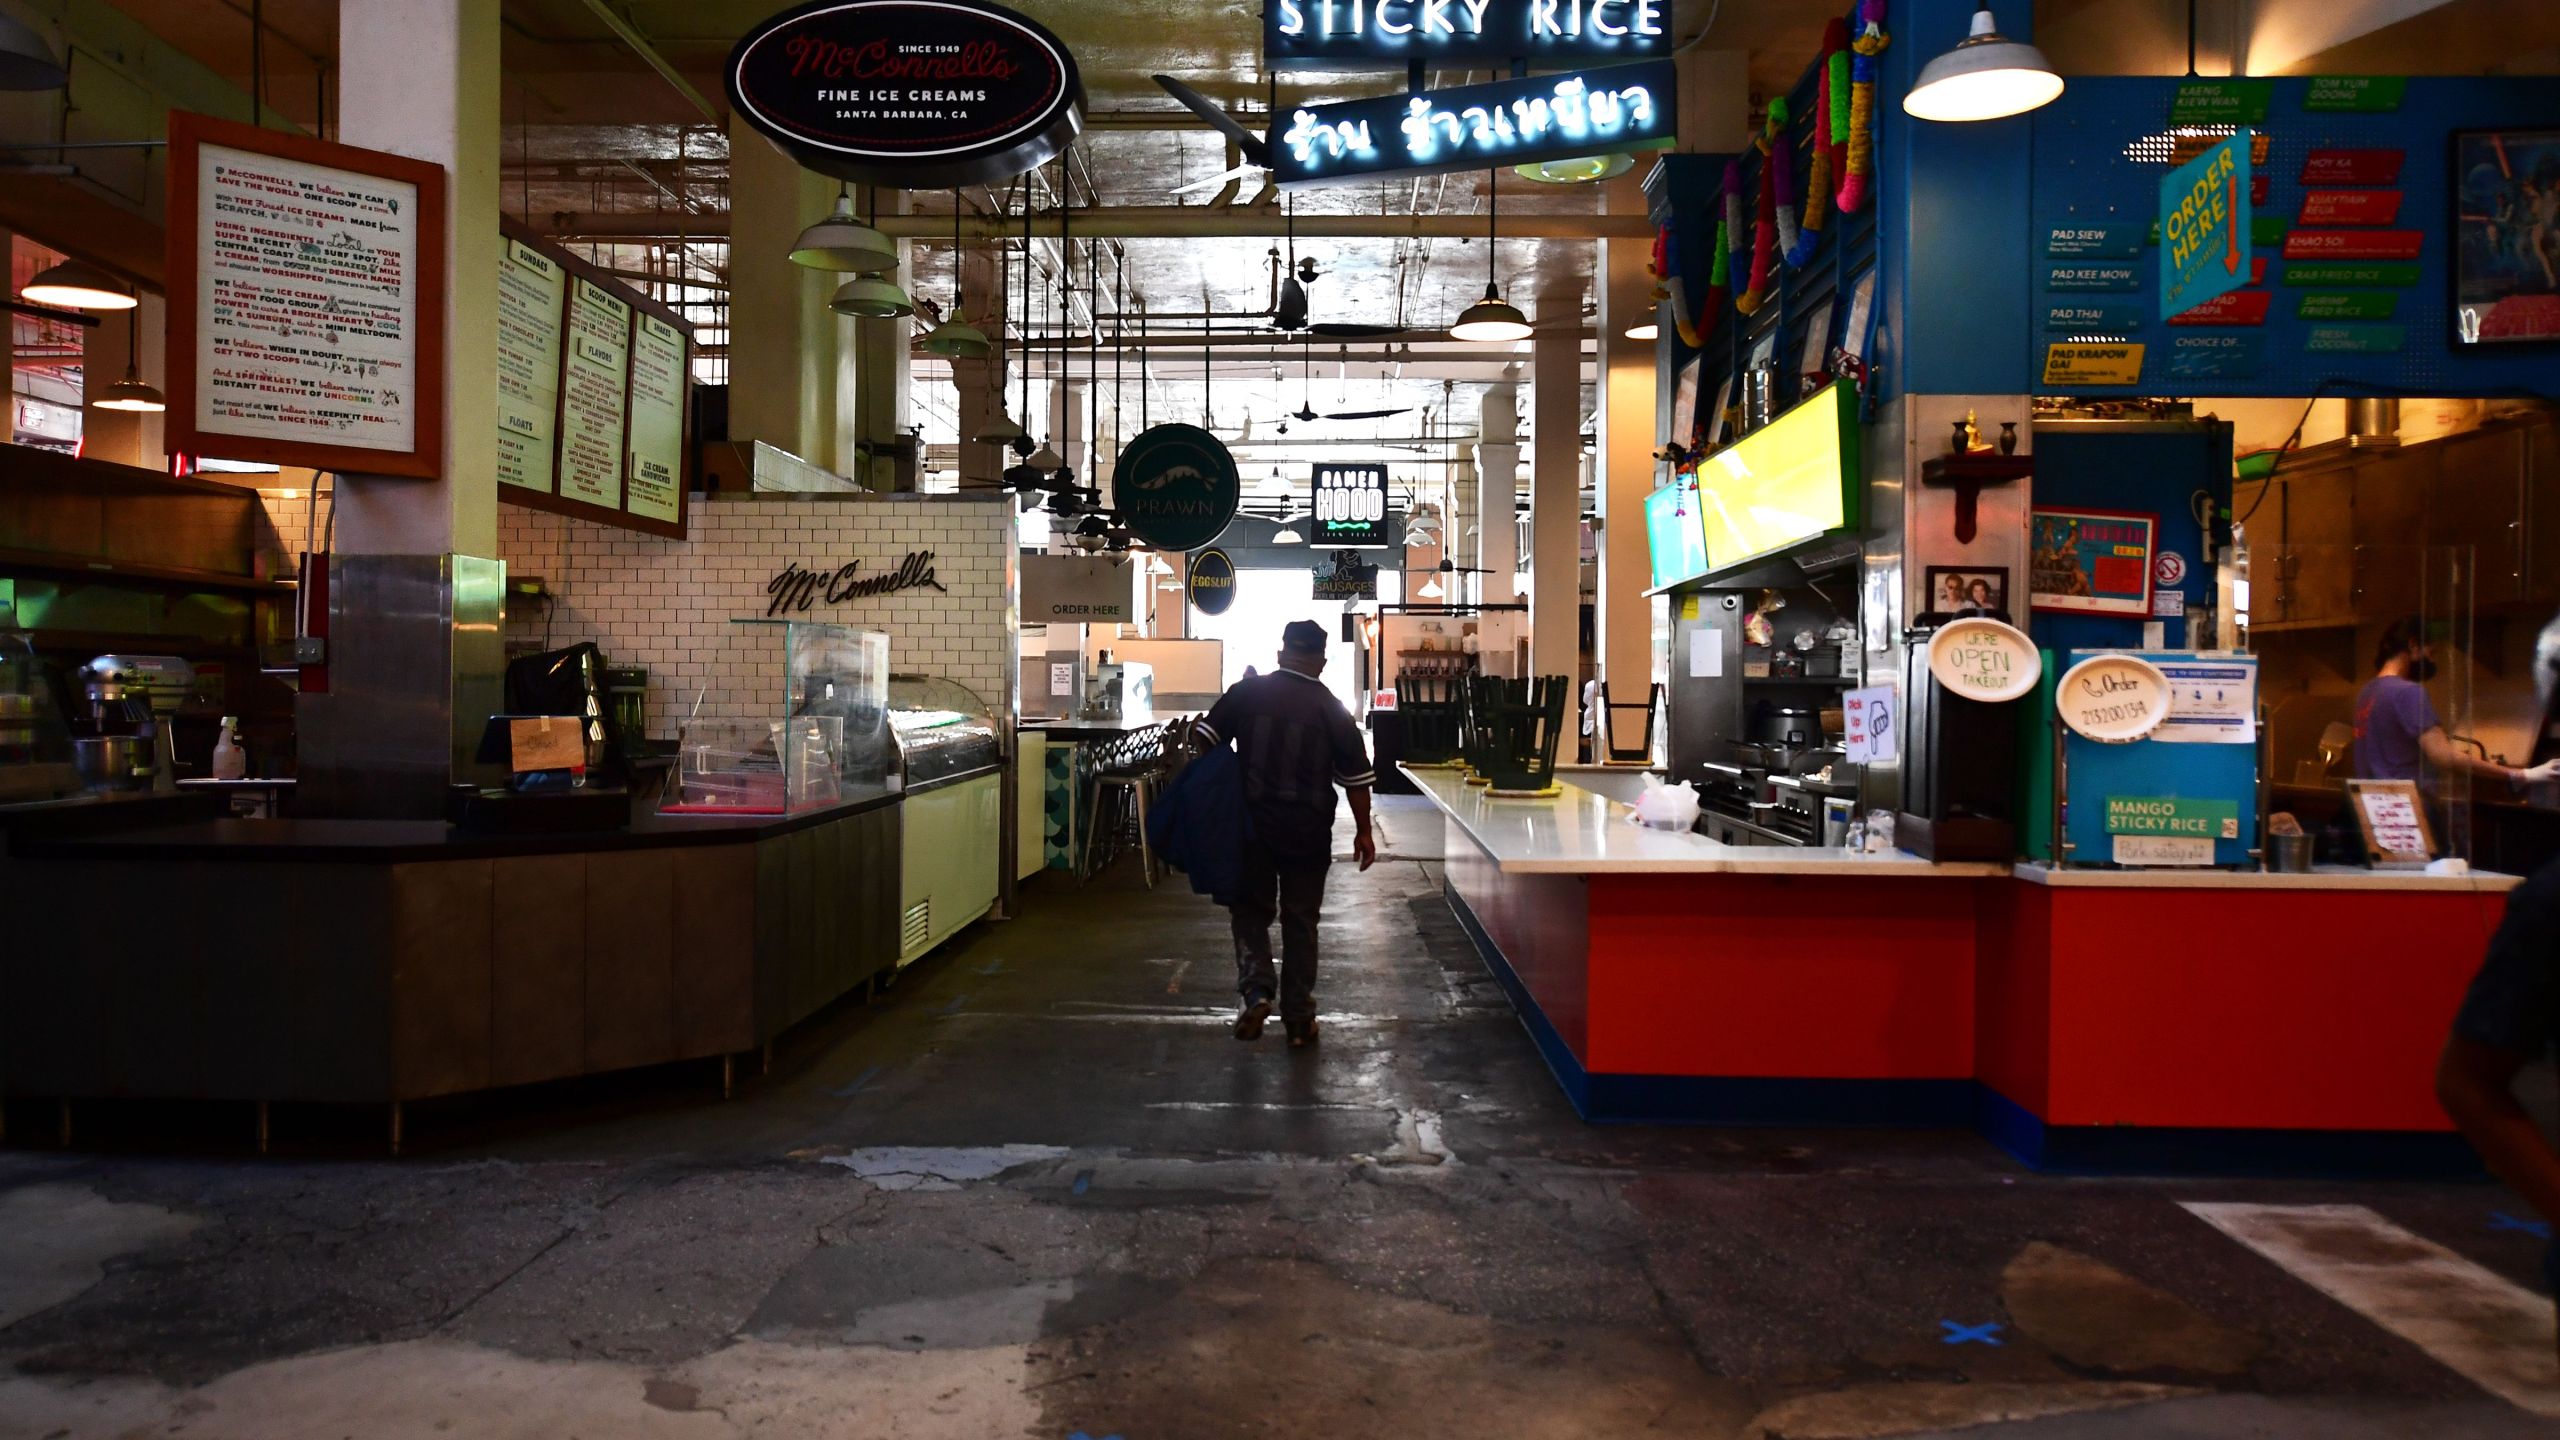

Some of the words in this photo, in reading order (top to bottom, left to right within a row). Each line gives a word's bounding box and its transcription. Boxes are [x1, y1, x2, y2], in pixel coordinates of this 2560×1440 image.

[1279, 0, 1487, 34] STICKY
[1533, 0, 1662, 35] RICE
[787, 37, 1020, 81] McConnell's
[818, 90, 860, 101] FINE
[869, 90, 900, 101] ICE
[909, 90, 987, 101] CREAMS
[2210, 97, 2240, 106] WAN
[836, 110, 877, 119] SANTA
[883, 110, 948, 120] BARBARA,
[952, 110, 968, 119] CA
[215, 176, 240, 186] SAVE
[243, 181, 262, 190] THE
[304, 192, 323, 201] ONE
[326, 196, 357, 207] SCOOP
[299, 182, 313, 190] WE
[347, 191, 361, 199] WE
[365, 194, 383, 203] CAN
[2167, 146, 2235, 241] ORDER
[234, 196, 252, 205] THE
[287, 206, 302, 214] ICE
[350, 217, 376, 228] MADE
[379, 220, 400, 235] from
[215, 221, 245, 232] USING
[250, 227, 313, 243] INGREDIENTS
[376, 248, 400, 258] YOUR
[2051, 230, 2075, 240] PAD
[2077, 230, 2106, 240] SIEW
[2172, 192, 2226, 270] HERE
[215, 230, 248, 242] SUPER
[252, 237, 290, 249] SECRET
[324, 248, 348, 258] SURF
[215, 240, 259, 253] CENTRAL
[262, 248, 294, 258] COAST
[379, 267, 400, 276] MILK
[519, 249, 549, 273] SUNDAES
[261, 266, 323, 282] WORSHIPPED
[328, 268, 367, 280] DESERVE
[370, 275, 400, 285] NAMES
[2051, 269, 2075, 279] PAD
[2076, 269, 2098, 279] KEE
[2099, 269, 2132, 280] MOW
[2356, 270, 2381, 280] RICE
[214, 278, 229, 286] WE
[277, 288, 291, 296] ICE
[294, 291, 326, 301] CREAM
[214, 288, 229, 296] ITS
[233, 291, 256, 300] OWN
[259, 295, 284, 304] FOOD
[587, 287, 607, 308] SCOOP
[607, 296, 623, 315] MENU
[214, 298, 249, 308] POWER
[291, 309, 328, 320] BROKEN
[332, 315, 362, 325] HEART
[376, 321, 400, 330] COOL
[214, 317, 235, 326] ETC.
[2050, 309, 2074, 319] PAD
[2076, 309, 2104, 319] THAI
[325, 323, 346, 332] MINI
[653, 321, 671, 340] SHAKES
[214, 337, 229, 345] WE
[268, 344, 296, 353] WHEN
[2175, 338, 2218, 347] CHOICE
[214, 347, 232, 355] GET
[236, 350, 259, 358] TWO
[263, 353, 299, 363] SCOOPS
[587, 344, 613, 364] FLAVORS
[2052, 349, 2076, 359] PAD
[2077, 349, 2128, 359] KRAPOW
[2050, 359, 2071, 369] GAI
[213, 379, 256, 389] DISTANT
[259, 384, 306, 395] RELATIVE
[235, 370, 297, 385] SPRINKLES?
[300, 379, 314, 387] WE
[263, 403, 278, 411] WE
[362, 414, 385, 423] REAL
[278, 415, 305, 423] SINCE
[509, 415, 533, 432] FLOATS
[1321, 470, 1379, 488] RAMEN
[1136, 498, 1215, 517] PRAWN
[1316, 488, 1383, 521] HOOD
[767, 550, 947, 617] McConnell's
[1192, 575, 1232, 588] EGGSLUT
[1314, 581, 1376, 592] SAUSAGES
[1052, 604, 1089, 615] ORDER
[1093, 605, 1120, 615] HERE
[1951, 647, 2010, 672] OPEN
[1961, 673, 2008, 688] TAKEOUT
[2102, 671, 2140, 694] Order
[2109, 801, 2176, 816] MANGO
[2109, 815, 2168, 830] STICKY
[2170, 818, 2208, 832] RICE
